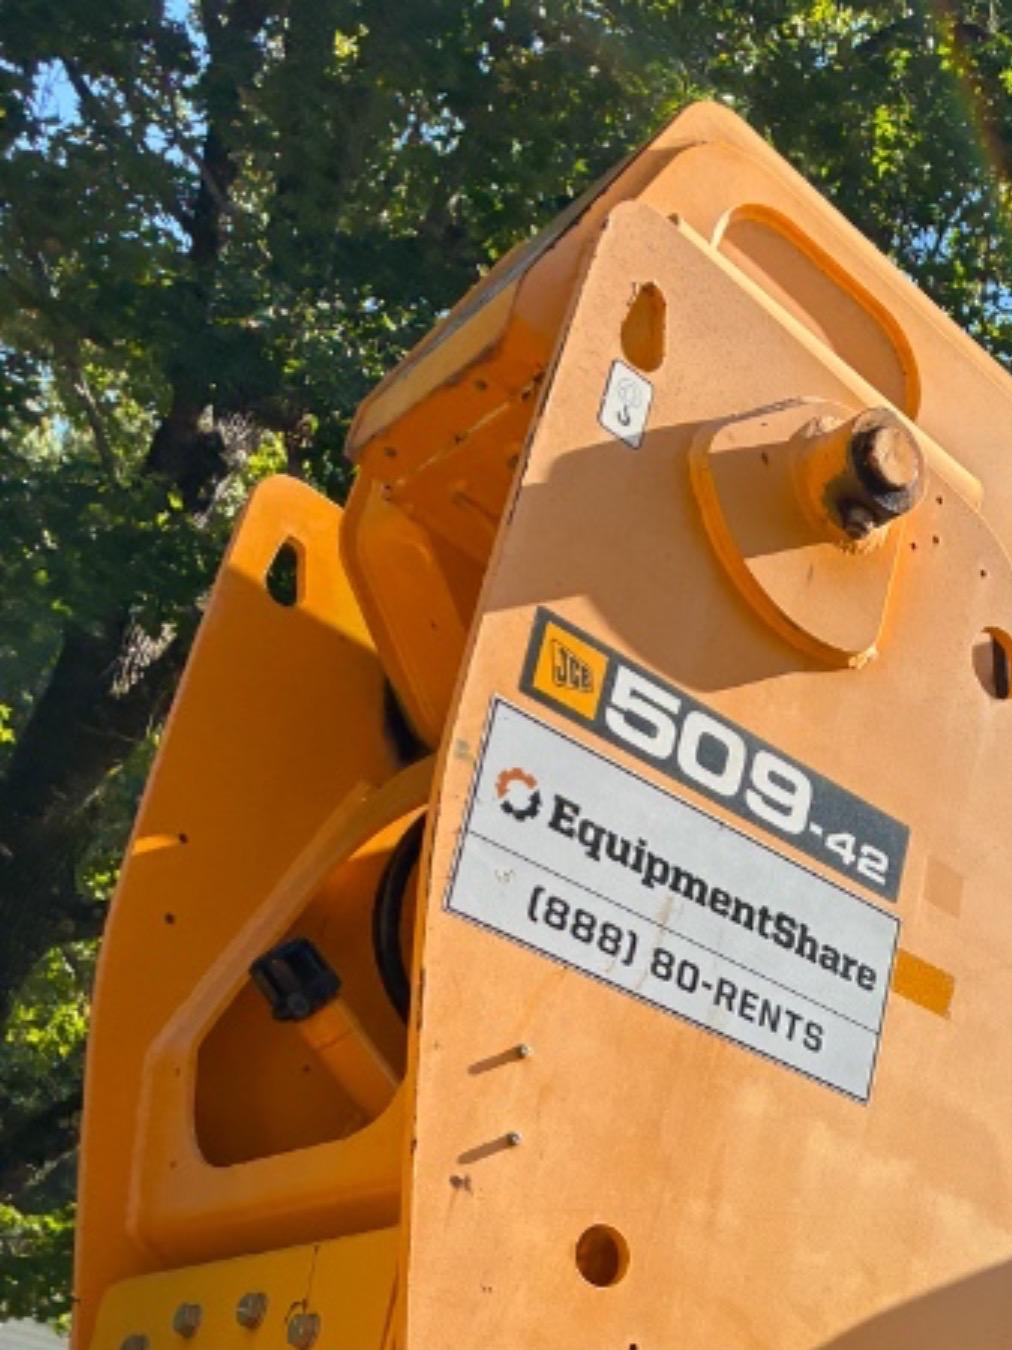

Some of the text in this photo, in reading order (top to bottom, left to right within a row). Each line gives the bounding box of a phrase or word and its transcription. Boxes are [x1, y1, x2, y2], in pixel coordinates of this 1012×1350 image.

[551, 644, 890, 887] JCB 509-42
[527, 885, 826, 1054] (888) 80-RENTS
[547, 792, 878, 992] EquipmentShare
